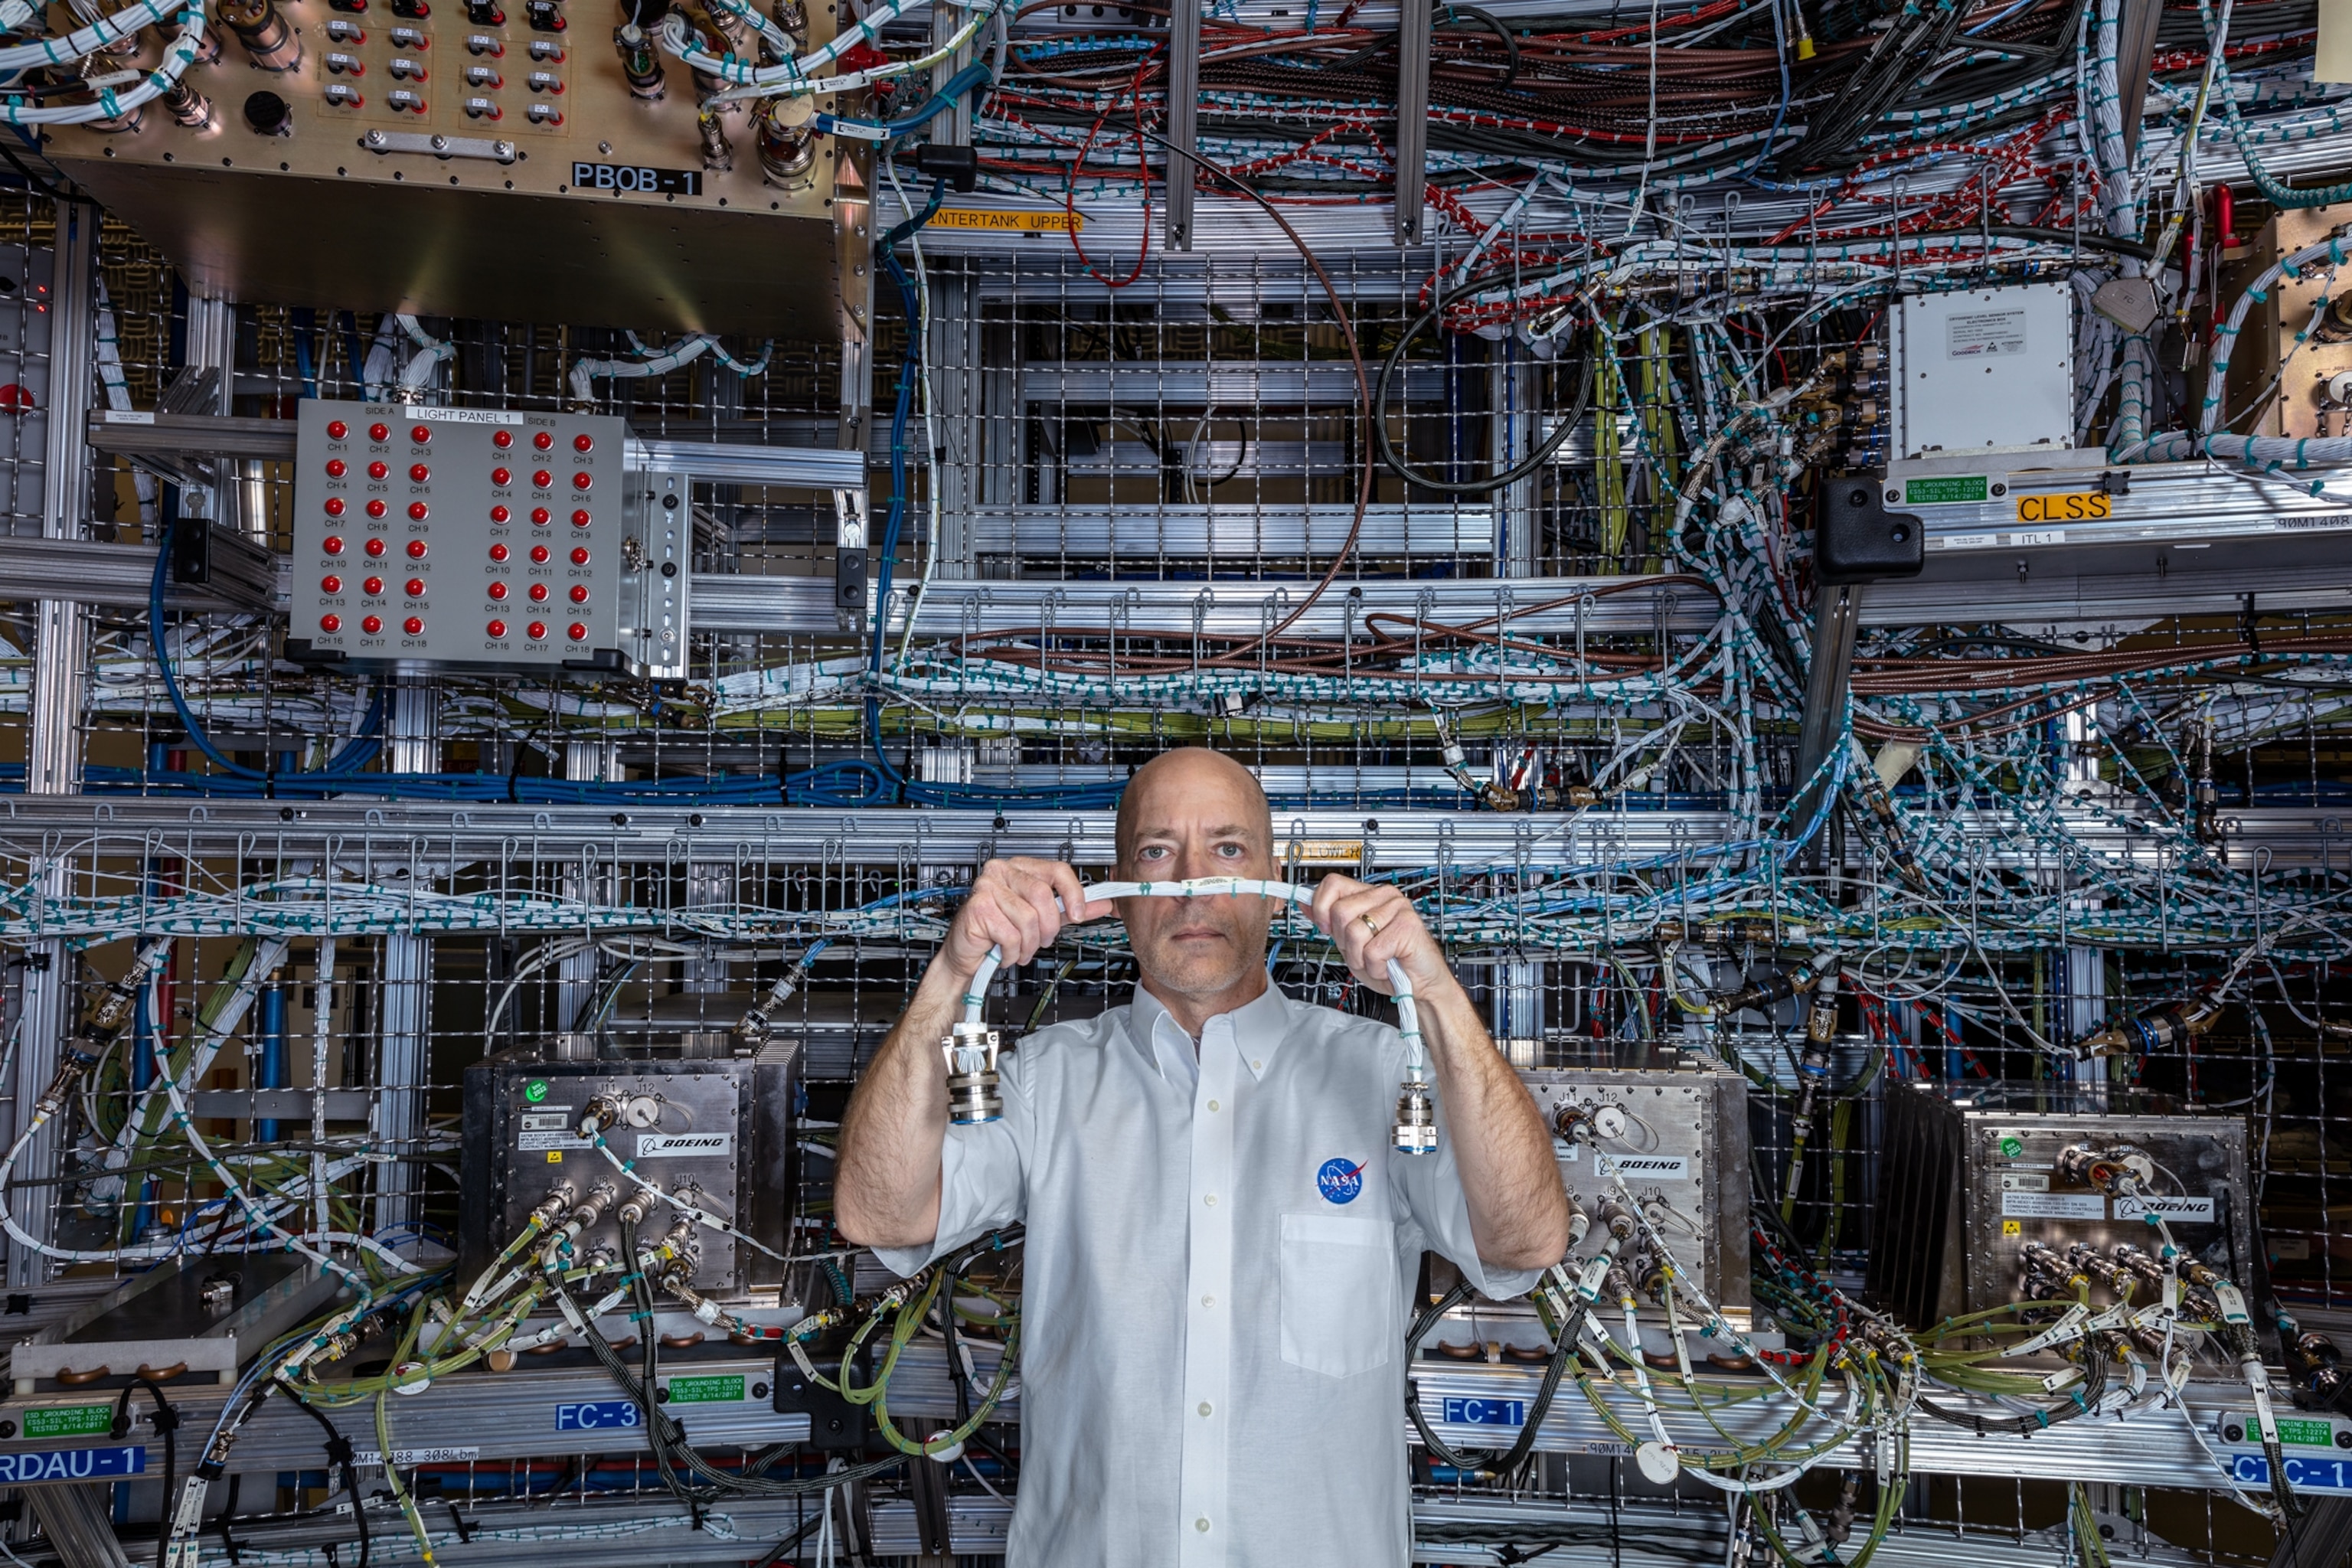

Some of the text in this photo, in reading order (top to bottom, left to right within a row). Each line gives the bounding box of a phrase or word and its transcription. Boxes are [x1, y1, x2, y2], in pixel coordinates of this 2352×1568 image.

[575, 163, 693, 195] PBOB-1
[929, 212, 1081, 229] INTERTANK UPPER
[417, 408, 511, 423] LIGHT PANEL 1
[528, 416, 547, 426] SIDE
[2019, 494, 2107, 521] CLSS
[2021, 533, 2052, 544] ITL 1
[485, 604, 509, 612] CH 13
[598, 1084, 616, 1093] J11
[635, 1083, 655, 1093] J12
[1559, 1092, 1577, 1101] J11
[1599, 1093, 1618, 1102] J12
[662, 1138, 724, 1148] BOEING
[1619, 1160, 1681, 1170] BOEING
[554, 1177, 567, 1187] J7
[595, 1176, 608, 1185] J8
[675, 1174, 694, 1184] J10
[1321, 1175, 1360, 1186] NASA
[1604, 1186, 1616, 1195] J9
[1642, 1186, 1661, 1196] J10
[2141, 1202, 2210, 1212] BOEING
[686, 1379, 722, 1387] GROUNDING
[676, 1390, 737, 1400] TESTED 8/14/2017
[43, 1408, 84, 1416] GROUNDING
[557, 1402, 637, 1429] FC-3
[1446, 1399, 1515, 1425] FC-1
[62, 1421, 103, 1431] 8/14/2017
